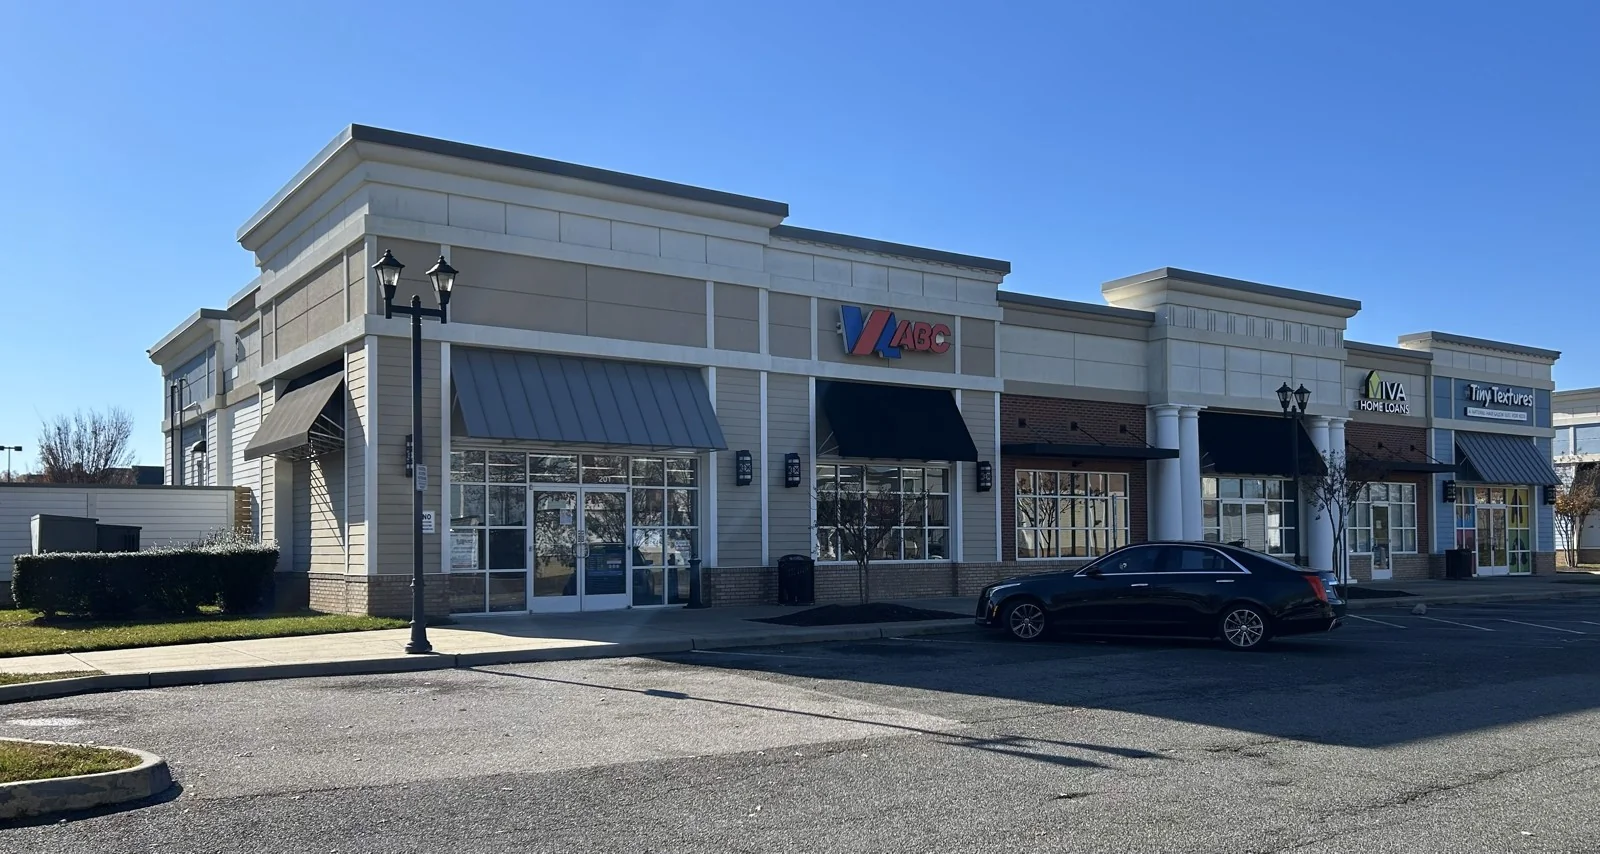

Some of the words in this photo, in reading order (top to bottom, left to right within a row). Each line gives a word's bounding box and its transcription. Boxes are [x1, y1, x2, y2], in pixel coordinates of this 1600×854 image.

[889, 319, 952, 354] ABC
[1470, 383, 1491, 408] Tiny
[1491, 386, 1533, 407] Textures
[1360, 400, 1383, 412] HOME
[1385, 402, 1410, 415] LOANS
[598, 475, 611, 483] 201
